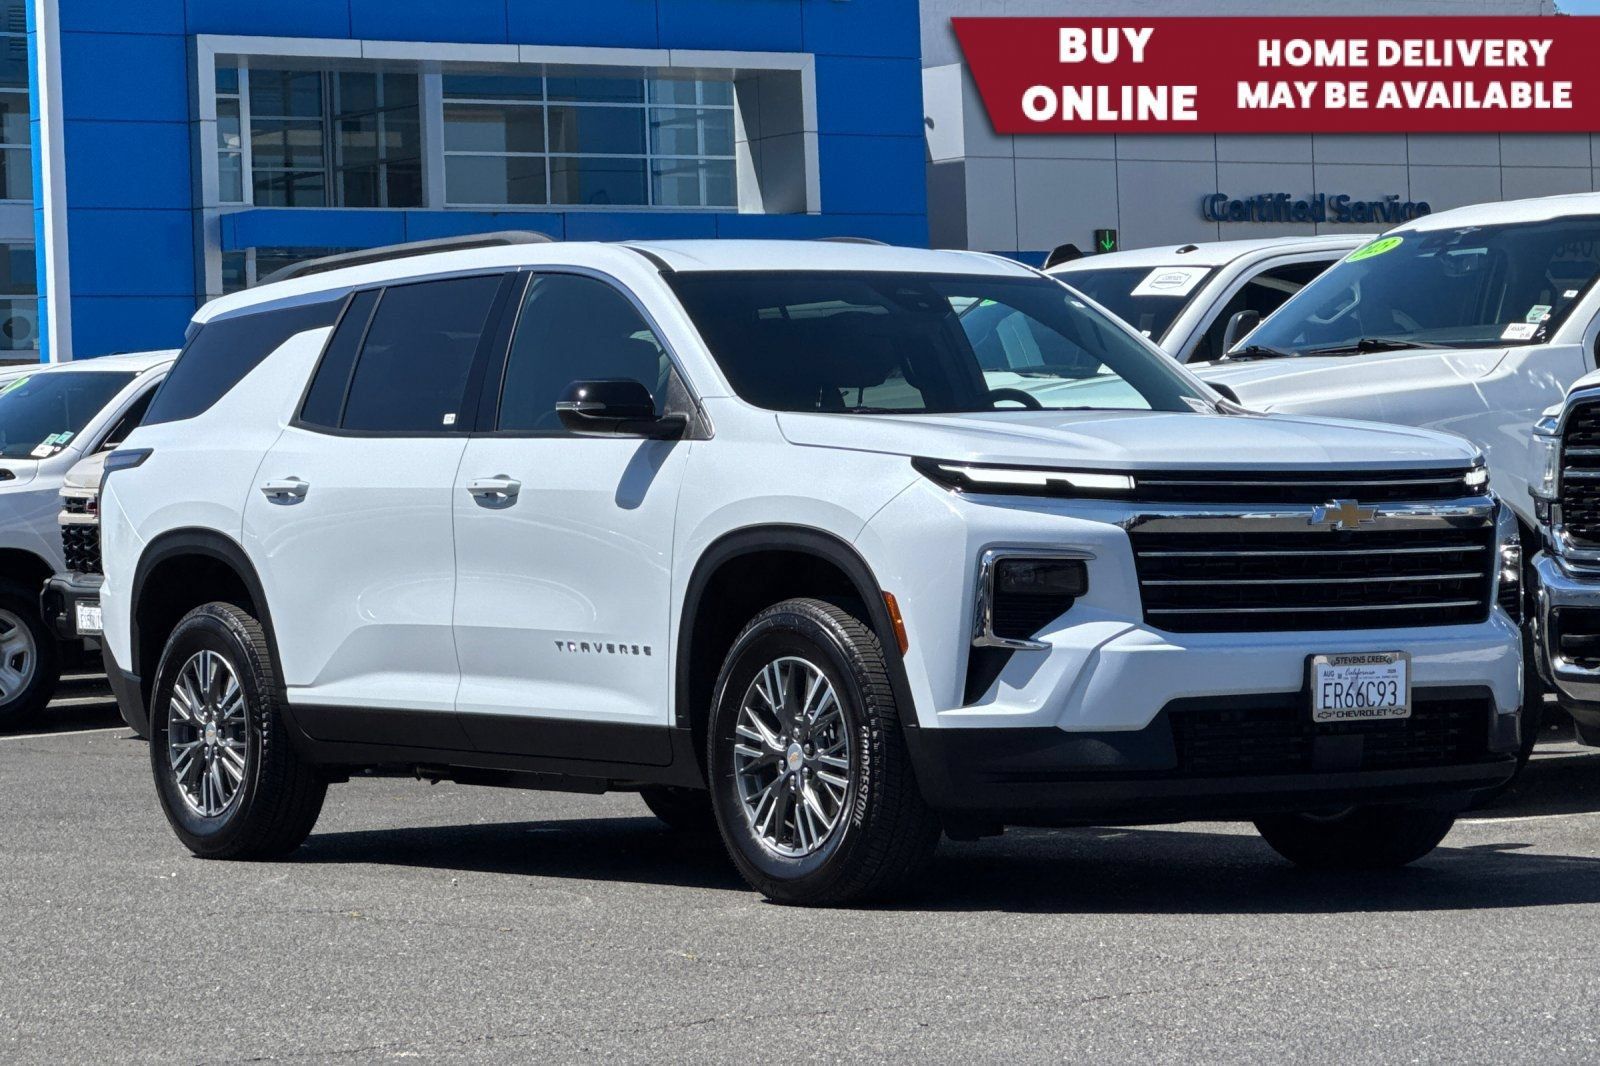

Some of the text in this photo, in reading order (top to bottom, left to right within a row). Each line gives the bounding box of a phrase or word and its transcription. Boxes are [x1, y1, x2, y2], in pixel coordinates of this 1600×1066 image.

[1203, 192, 1431, 223] Certified Service
[554, 640, 652, 656] TRAVERSE
[1335, 655, 1389, 665] STEVENS CREEK
[1345, 667, 1376, 680] California
[1323, 681, 1397, 709] ER66C93
[1336, 709, 1388, 718] CHEVROLET
[852, 725, 871, 828] BRIDGESTONE
